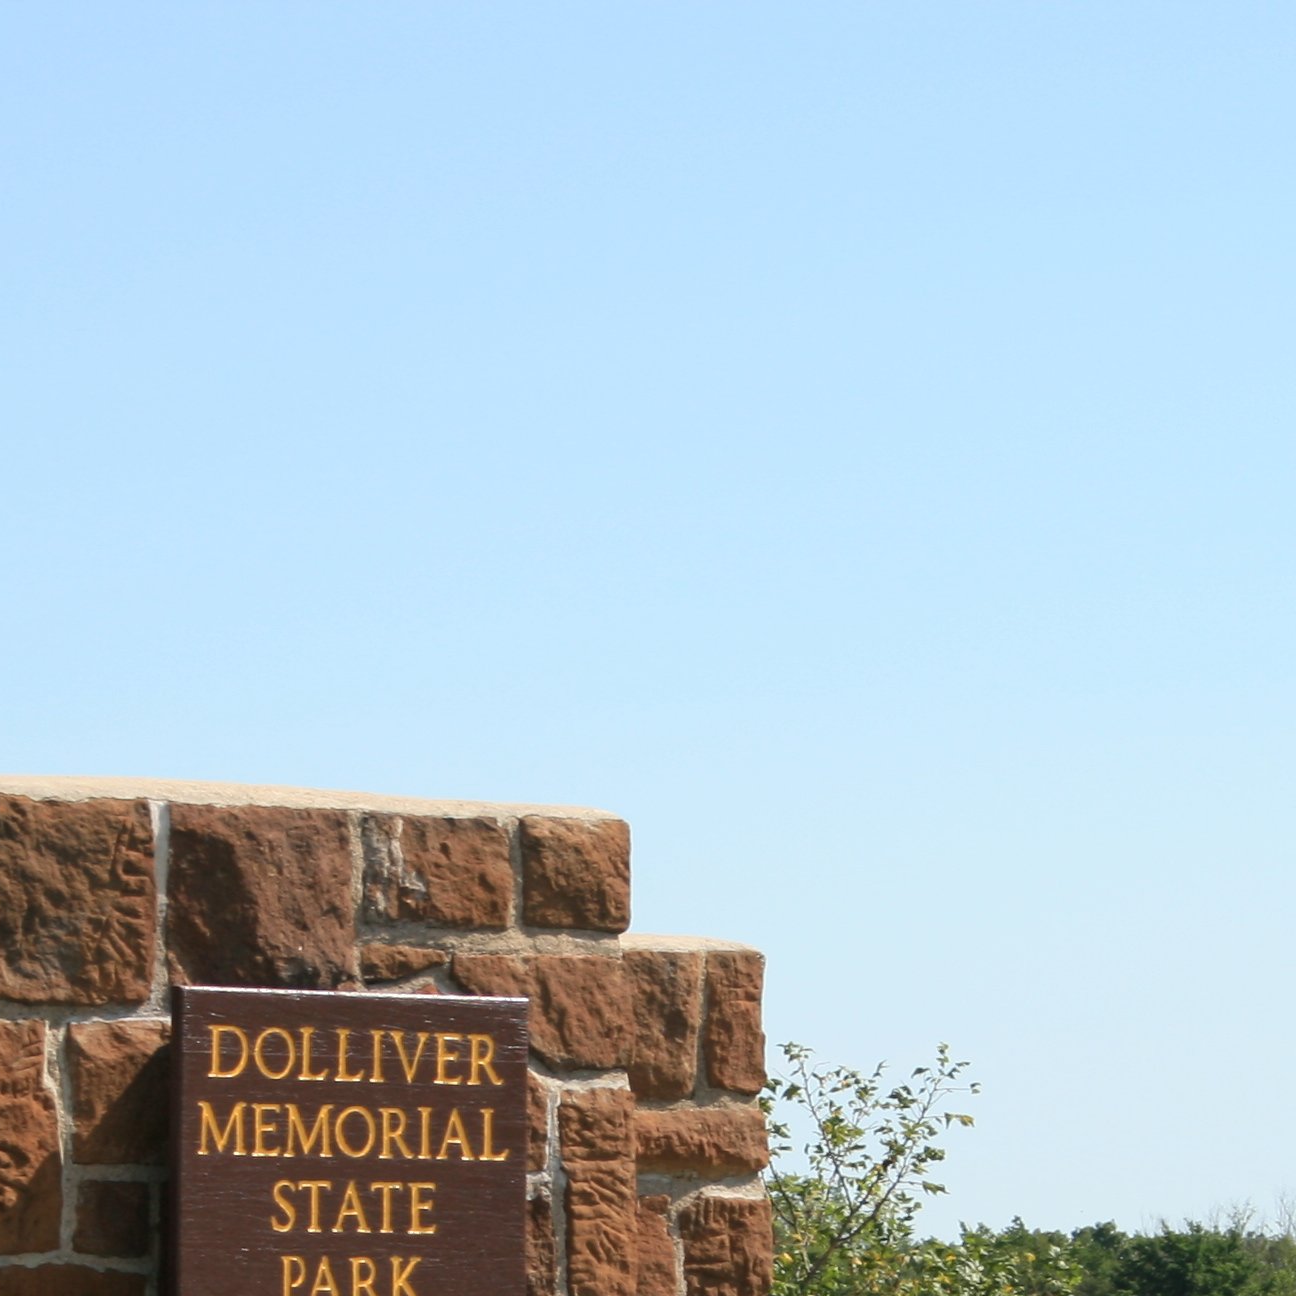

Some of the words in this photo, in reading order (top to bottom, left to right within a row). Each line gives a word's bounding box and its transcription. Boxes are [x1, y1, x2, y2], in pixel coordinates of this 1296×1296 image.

[207, 1024, 504, 1085] DOLLIVER
[197, 1100, 511, 1161] MEMORIAL
[271, 1178, 437, 1233] STATE
